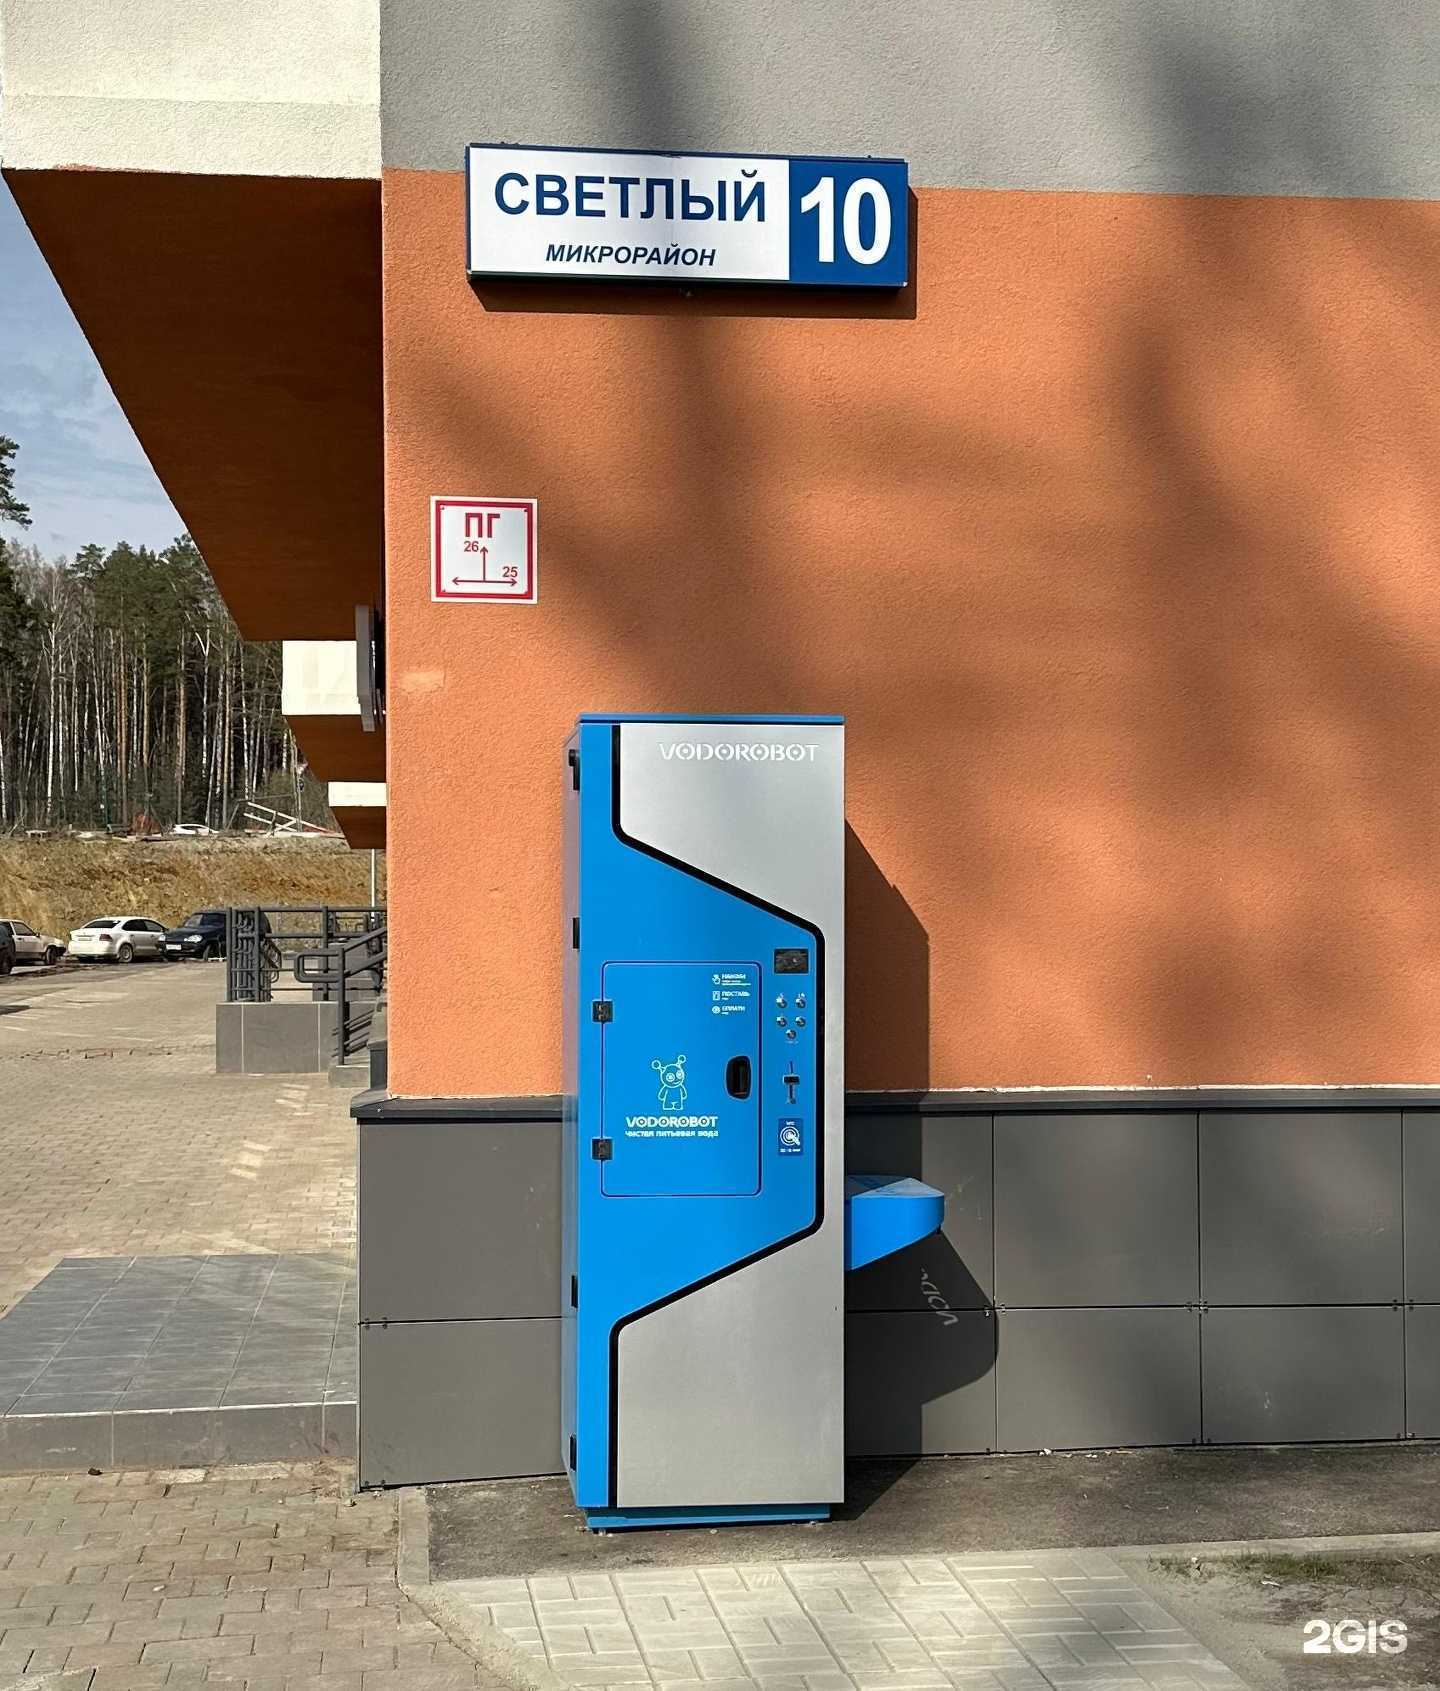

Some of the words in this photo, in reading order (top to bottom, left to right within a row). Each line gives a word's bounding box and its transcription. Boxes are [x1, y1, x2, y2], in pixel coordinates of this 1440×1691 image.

[494, 169, 766, 223] СВЕТЛЫЙ
[799, 176, 892, 265] 10
[545, 243, 716, 267] МИКРОРАЙОН
[465, 512, 500, 538] ПГ
[463, 541, 479, 552] 26
[502, 566, 518, 577] 25
[658, 743, 819, 762] VODOROBOT
[625, 1116, 718, 1128] VODOROBOT
